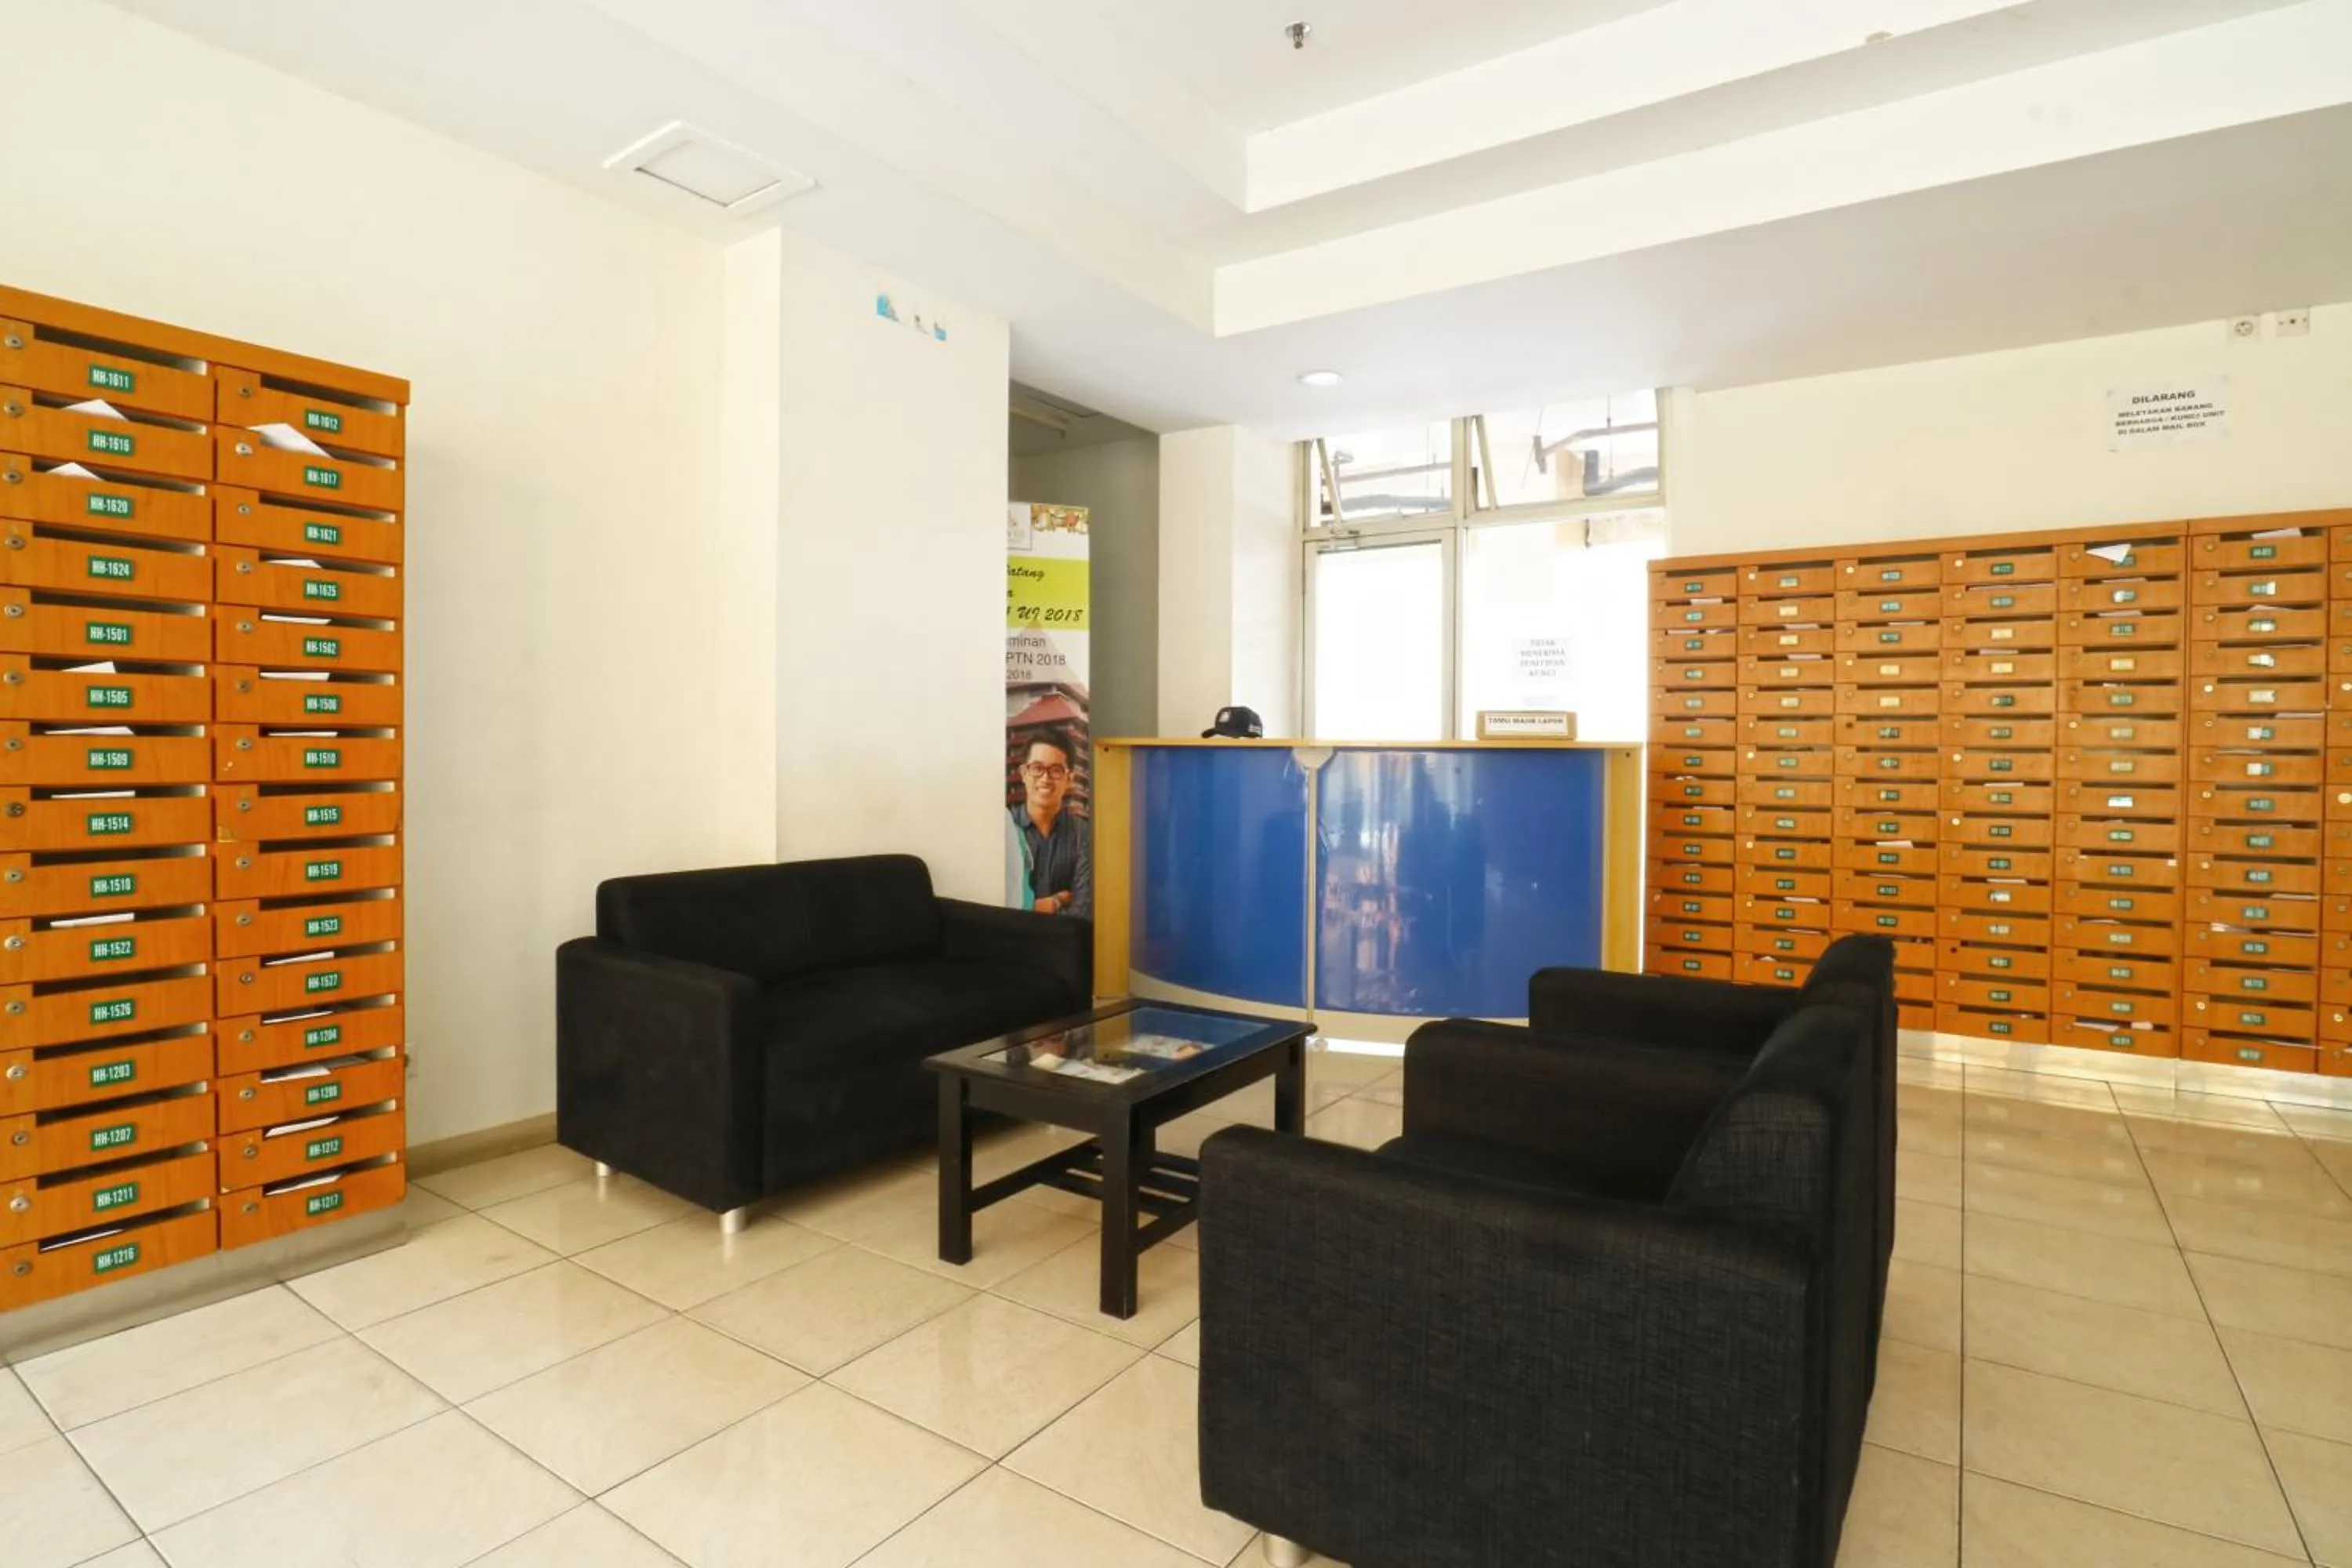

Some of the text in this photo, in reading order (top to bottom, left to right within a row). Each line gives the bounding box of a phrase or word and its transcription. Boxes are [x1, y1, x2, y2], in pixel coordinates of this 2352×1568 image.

[92, 368, 129, 388] HH-1611
[2132, 390, 2195, 404] DILARANG
[307, 413, 338, 430] HH-1612
[93, 433, 130, 452] HH-1616
[307, 469, 336, 485] HH-1617
[90, 497, 129, 514] HH-1620
[307, 525, 336, 541] HH-1621
[92, 560, 129, 575] HH-1624
[1044, 608, 1083, 622] 2018
[90, 626, 126, 641] HH-1501
[306, 641, 336, 655] HH-1502
[1036, 653, 1066, 666] 2018
[91, 690, 127, 704] HH-1505
[90, 752, 128, 766] HH-1509
[307, 808, 338, 822] HH-1515
[91, 816, 129, 831] HH-1514
[94, 941, 131, 957] HH-1522
[94, 1002, 131, 1020] HH-1526
[93, 1065, 130, 1083] HH-1203
[95, 1127, 131, 1146] HH-1207
[310, 1141, 338, 1156] HH-1212
[96, 1186, 133, 1208] HH-1211
[309, 1196, 338, 1212] HH-1217
[97, 1247, 135, 1269] HH-1216
